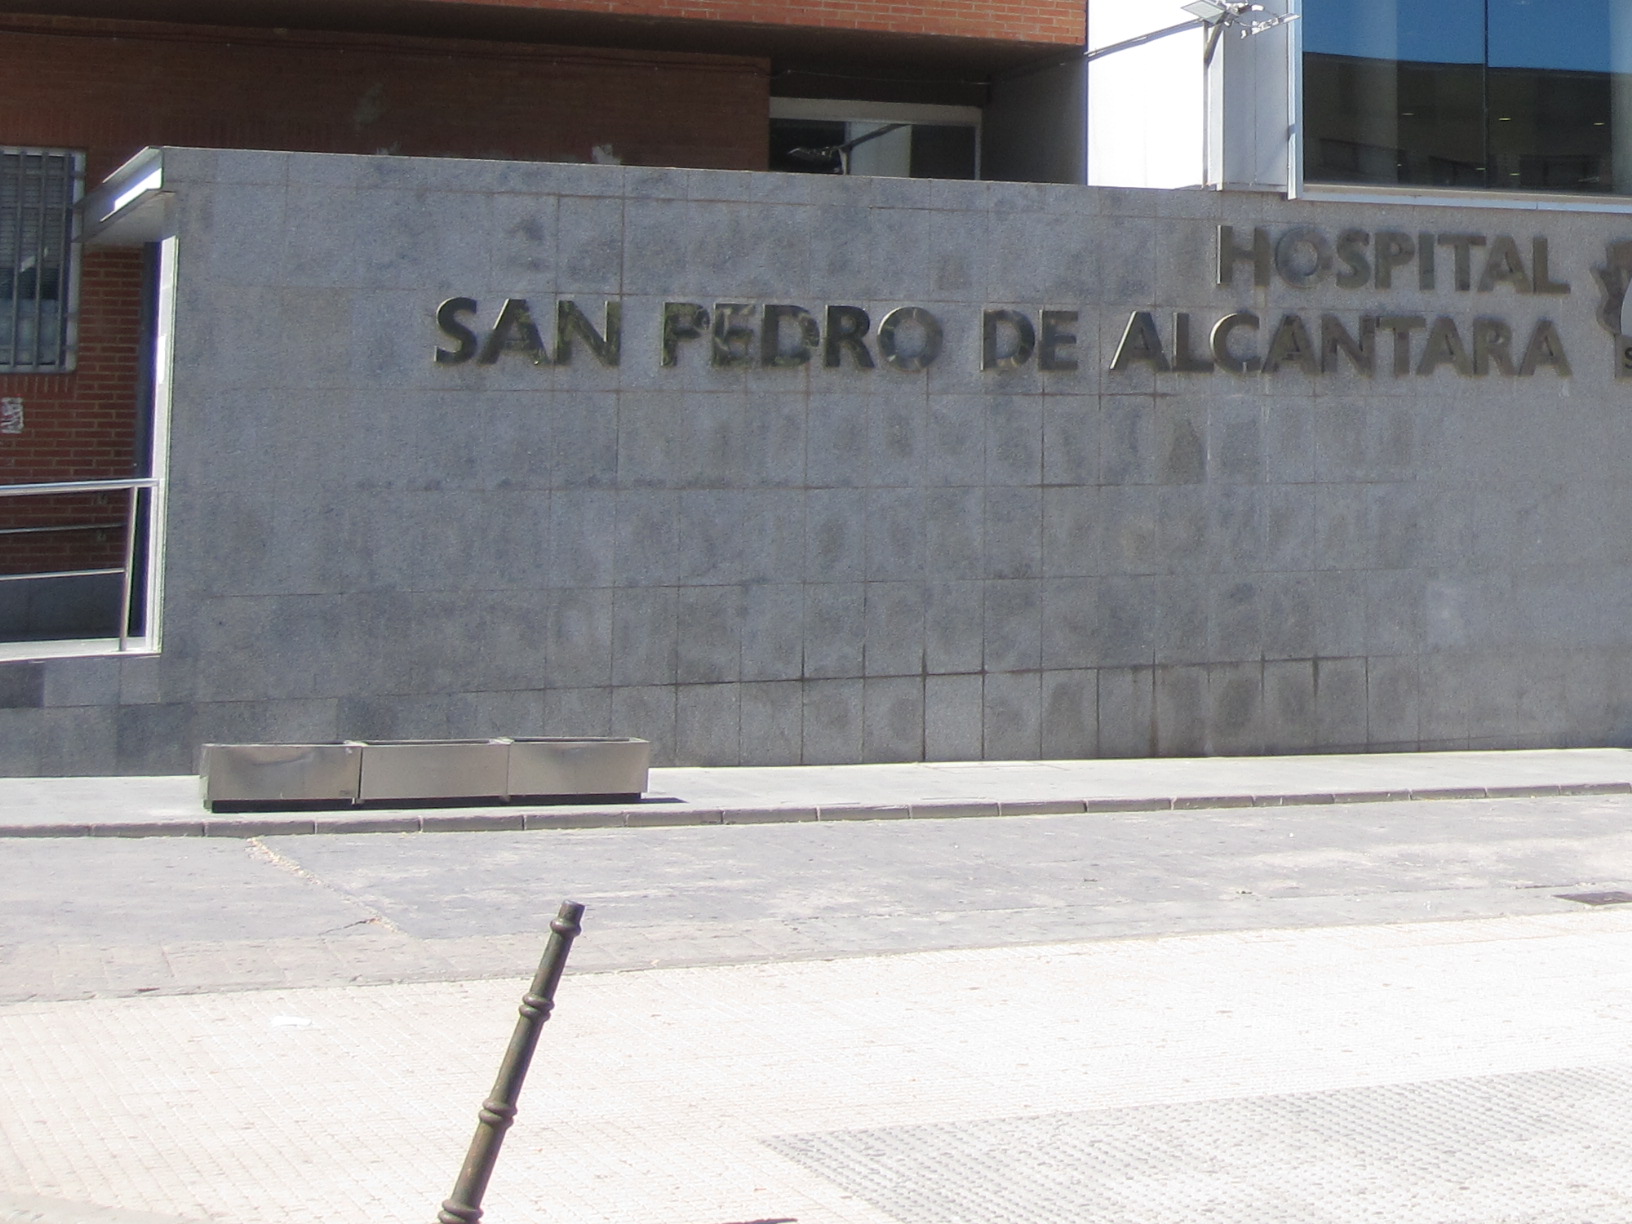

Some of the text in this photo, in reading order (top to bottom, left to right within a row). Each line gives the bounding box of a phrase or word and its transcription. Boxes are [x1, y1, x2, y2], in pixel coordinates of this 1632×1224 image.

[1216, 224, 1570, 294] HOSPITAL
[434, 297, 1573, 377] SAN PEDRO DE ALCANTARA
